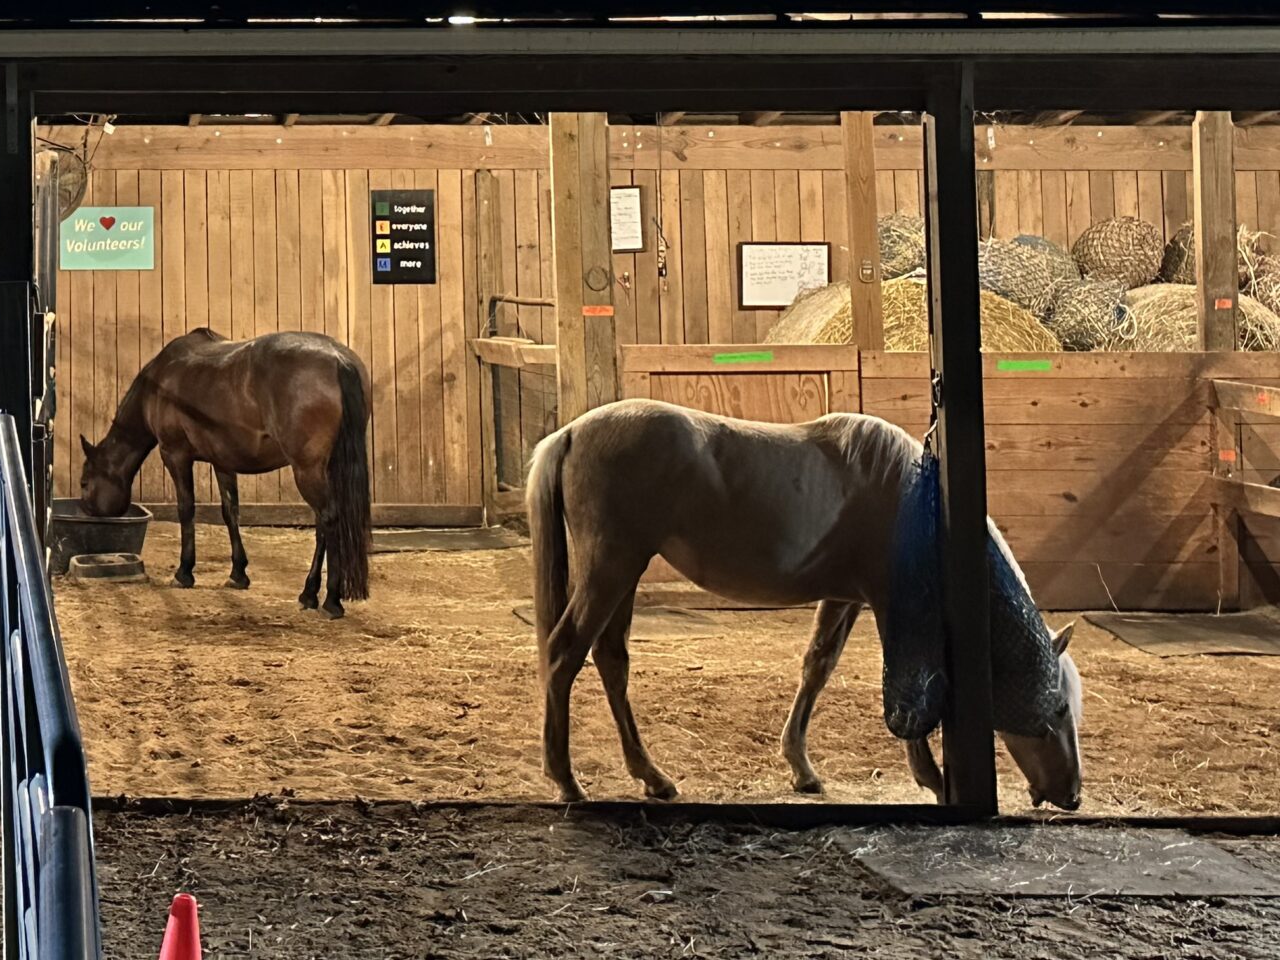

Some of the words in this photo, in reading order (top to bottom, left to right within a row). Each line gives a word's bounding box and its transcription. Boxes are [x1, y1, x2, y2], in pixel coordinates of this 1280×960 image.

[394, 205, 426, 215] together
[74, 219, 96, 232] We
[120, 220, 144, 231] our
[392, 224, 427, 232] everyone
[66, 236, 146, 253] Volunteers!
[393, 240, 429, 250] achieves
[400, 260, 422, 269] more
